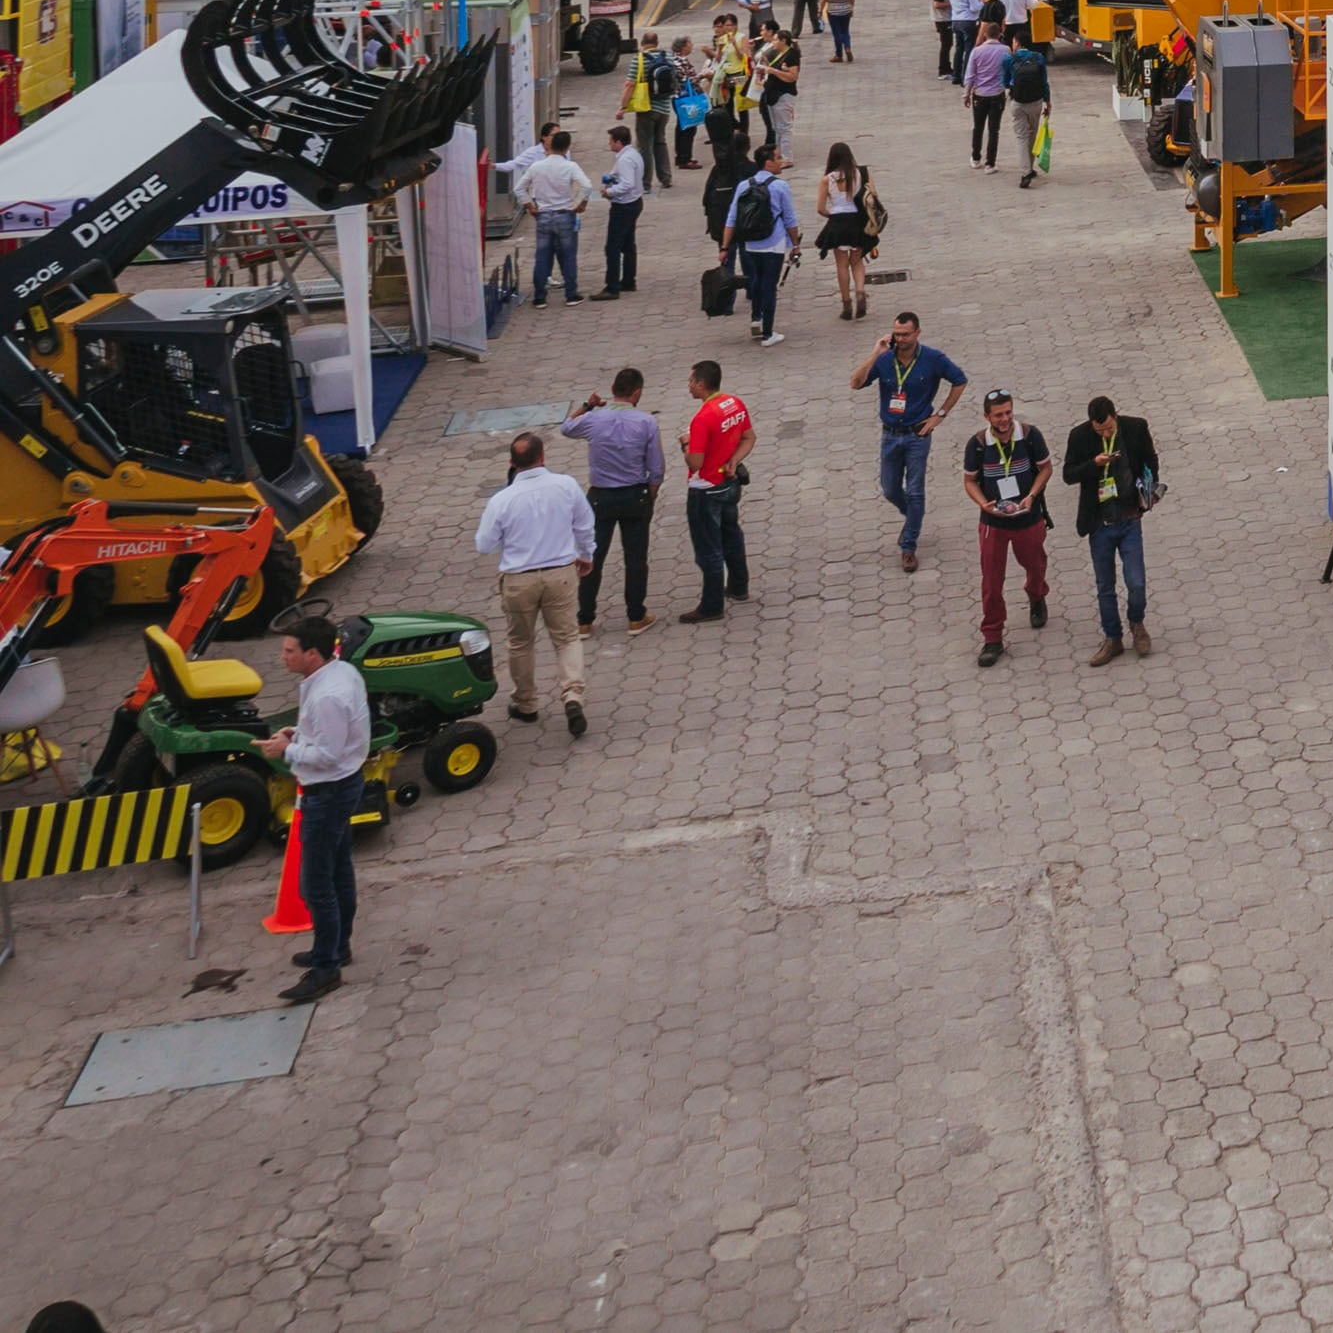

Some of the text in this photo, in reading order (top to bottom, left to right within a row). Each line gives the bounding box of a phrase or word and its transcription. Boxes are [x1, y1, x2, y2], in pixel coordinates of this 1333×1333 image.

[71, 174, 168, 249] DEERE
[13, 260, 64, 299] 320E
[720, 409, 748, 434] STAFF
[97, 538, 168, 559] HITACHI
